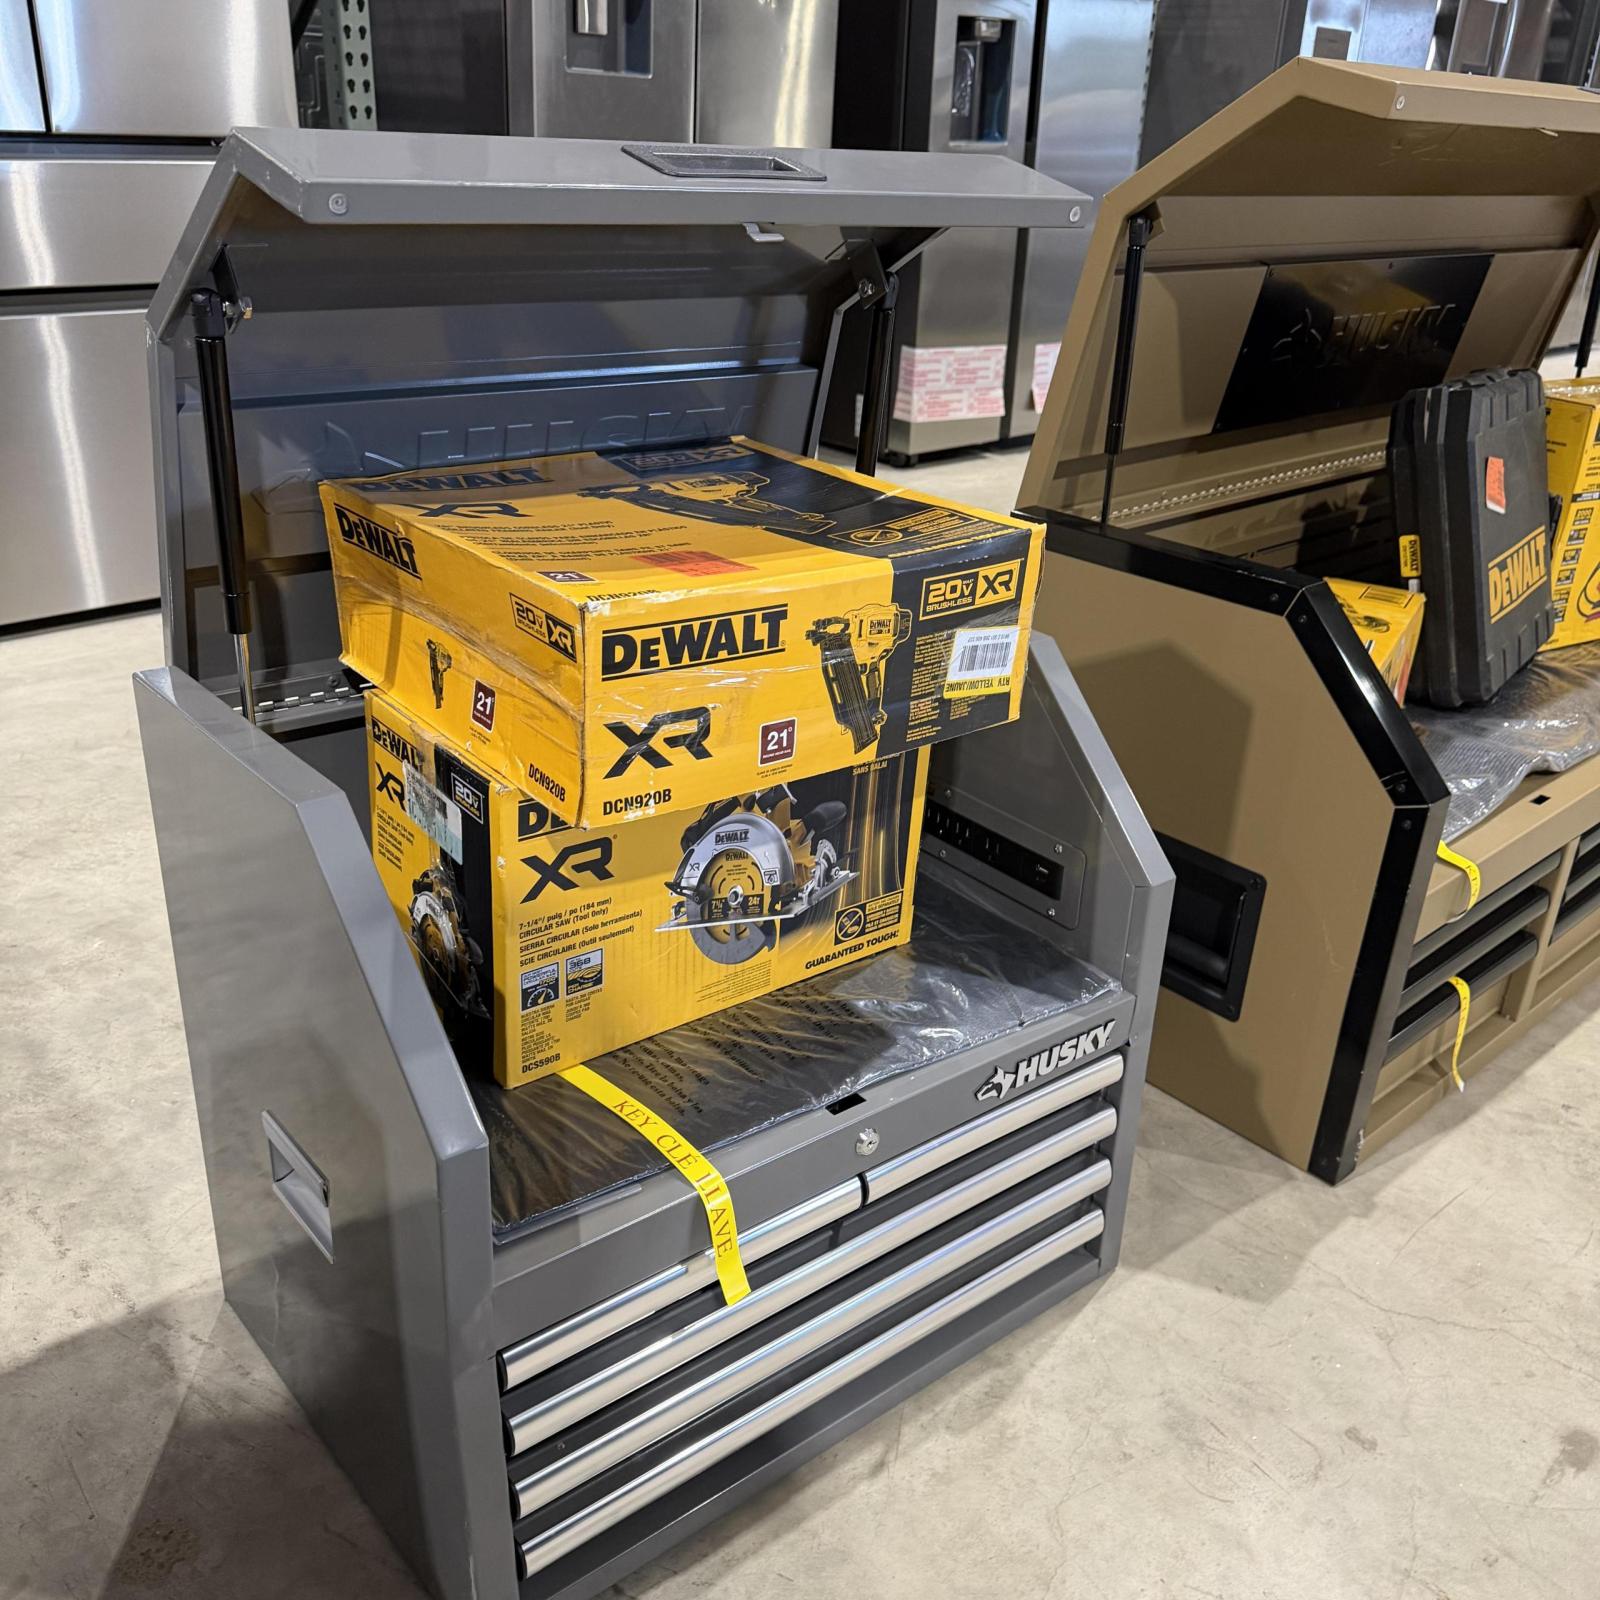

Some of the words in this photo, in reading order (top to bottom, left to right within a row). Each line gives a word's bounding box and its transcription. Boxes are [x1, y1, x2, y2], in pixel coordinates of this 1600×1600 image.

[979, 569, 1016, 599] XR
[926, 597, 973, 612] BRUSHLESS
[548, 620, 574, 653] XR
[603, 706, 713, 779] XR
[528, 763, 566, 802] DCN920B
[603, 788, 672, 816] DCN920B
[519, 836, 616, 904] XR
[519, 924, 554, 940] CIRCULAR
[555, 919, 572, 928] SAW
[572, 913, 590, 925] (Tool
[591, 906, 609, 918] Only)
[579, 901, 595, 913] (184
[519, 941, 545, 954] SIERRA
[546, 929, 580, 945] CIRCULAR
[581, 923, 599, 936] (Solo
[600, 909, 643, 927] herramienta)
[519, 956, 536, 967] SCIE
[536, 942, 577, 961] CIRCULAIRE
[578, 936, 597, 949] (Outil
[598, 925, 635, 942] seulement)
[805, 943, 865, 970] GUARANTEED
[522, 1053, 561, 1074] DCS590B
[1015, 1019, 1116, 1088] HUSKY
[612, 1100, 658, 1128] KEY
